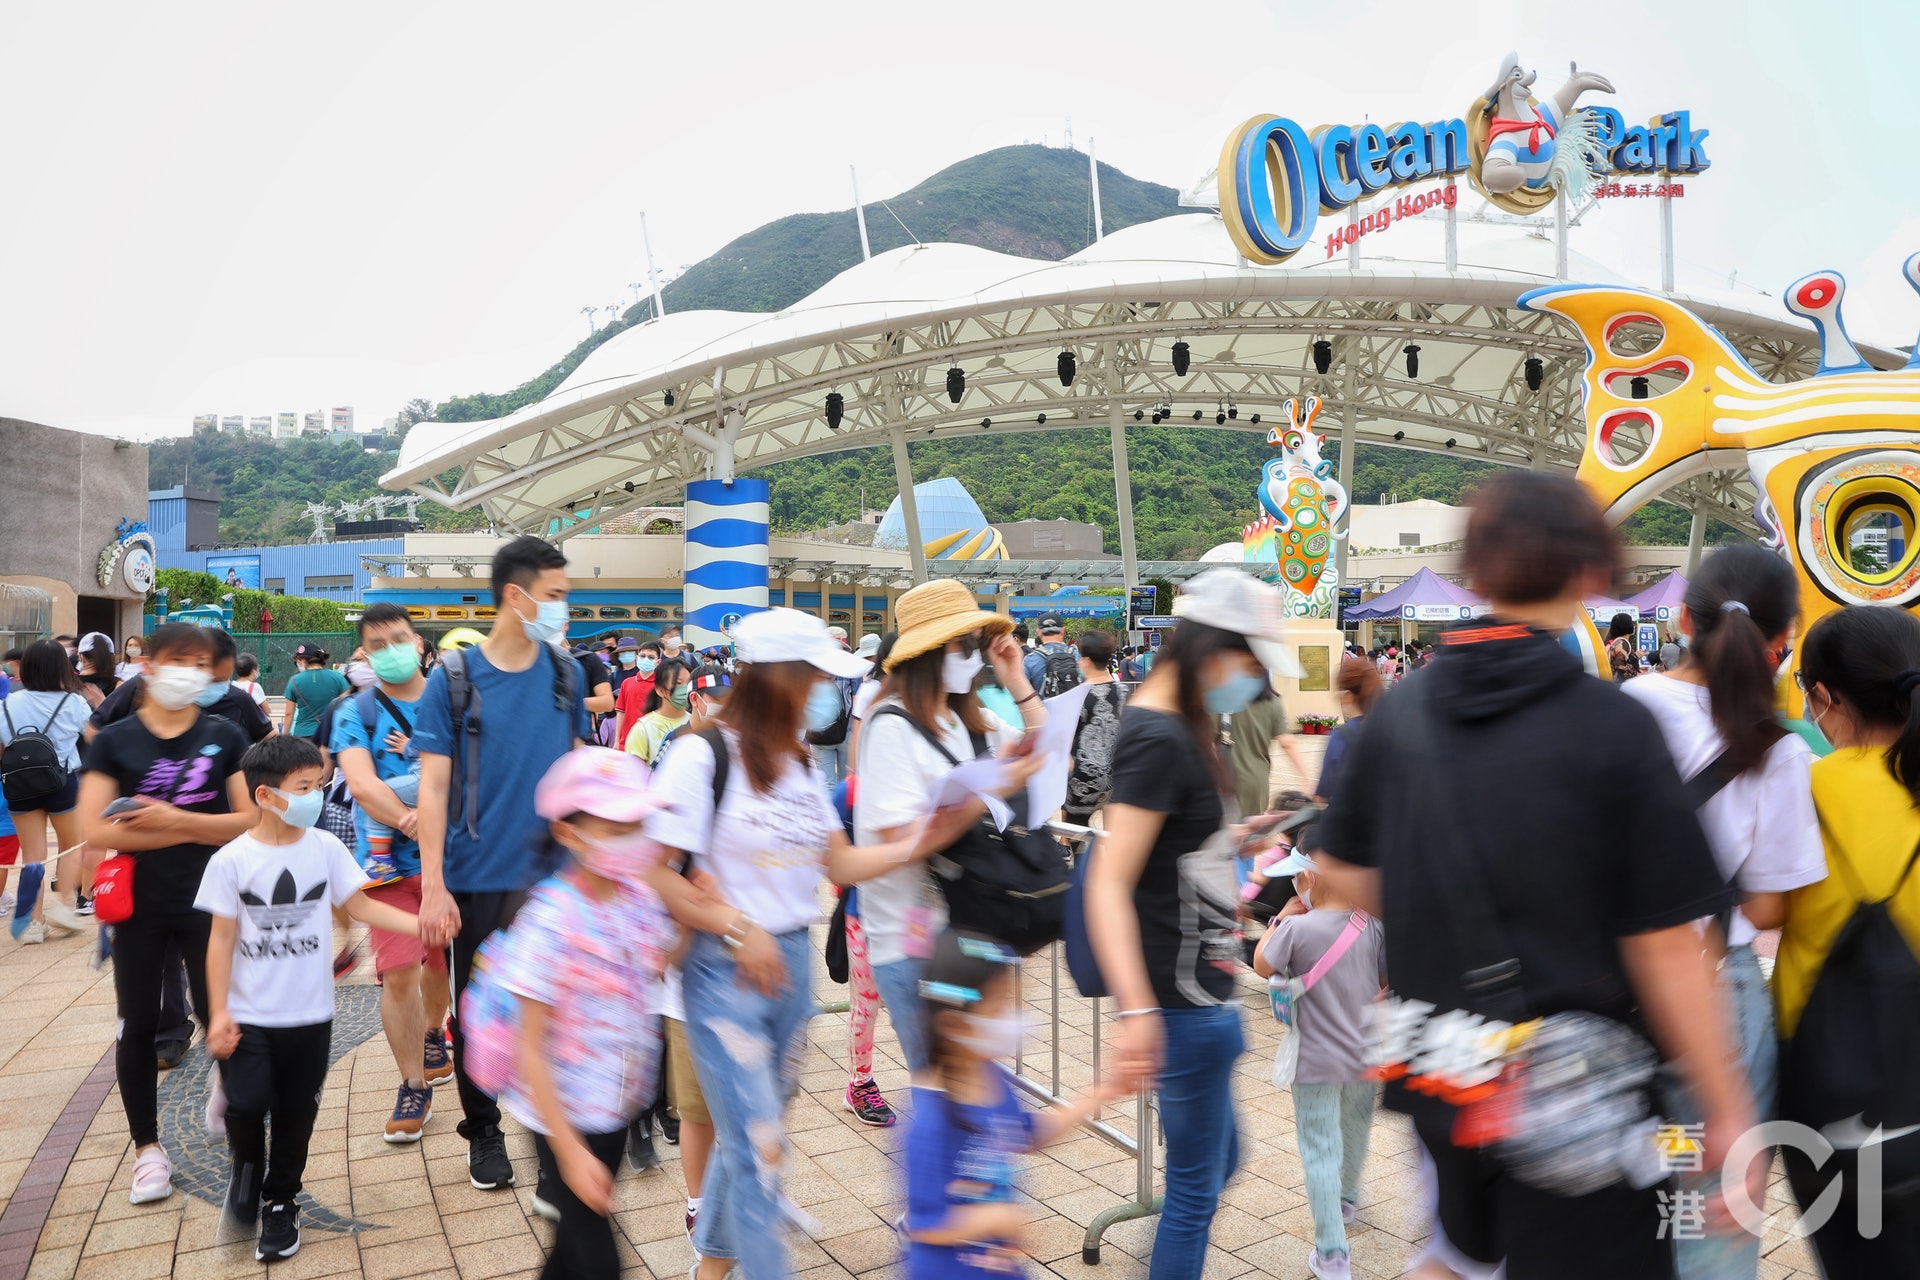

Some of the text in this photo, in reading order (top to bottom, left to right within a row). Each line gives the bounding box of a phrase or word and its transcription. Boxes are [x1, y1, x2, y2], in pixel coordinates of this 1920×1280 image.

[1228, 105, 1712, 260] Ocean Park
[1326, 184, 1457, 260] Hong Kong
